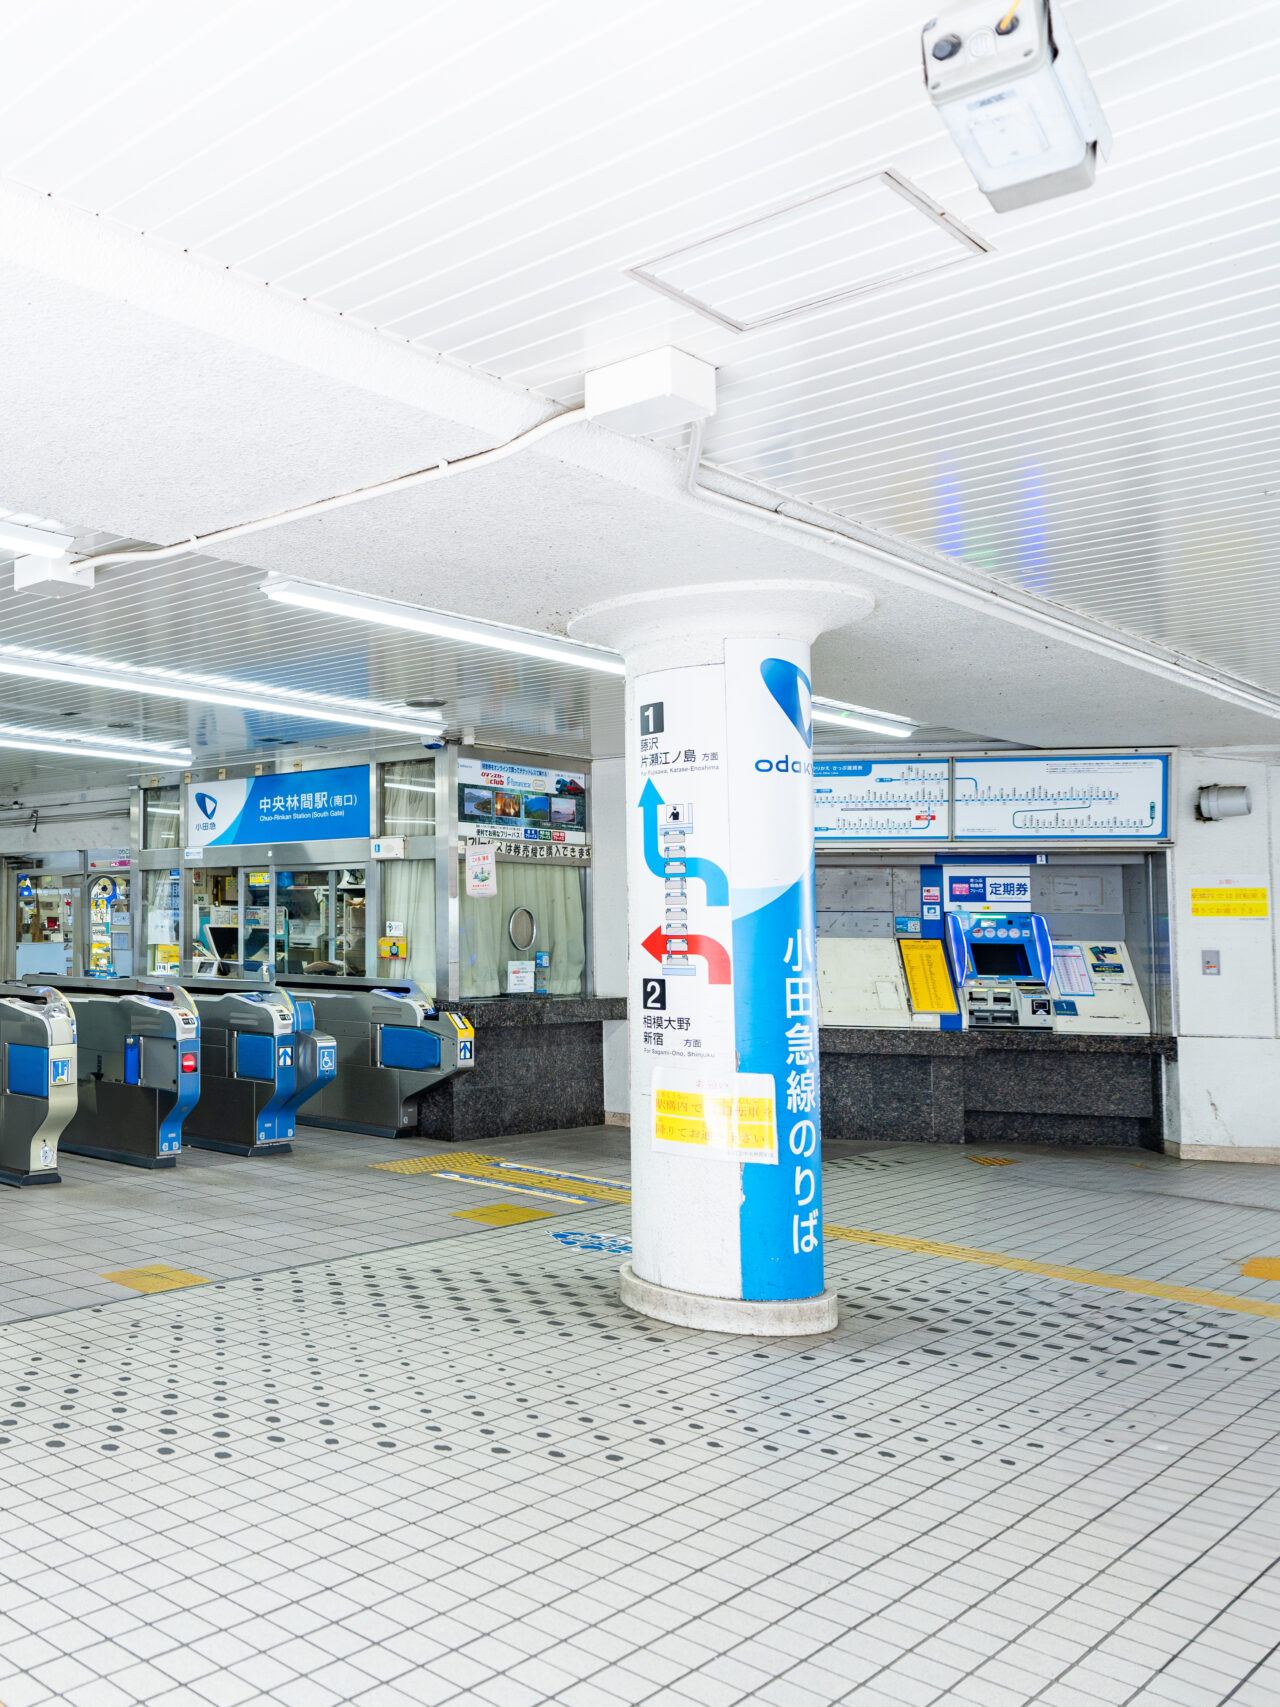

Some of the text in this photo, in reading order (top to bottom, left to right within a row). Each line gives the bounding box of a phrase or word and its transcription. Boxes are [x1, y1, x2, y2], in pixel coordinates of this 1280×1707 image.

[644, 707, 654, 733] 1
[641, 737, 658, 752] 藤沢
[641, 749, 719, 768] 片瀬江ノ島 方面
[259, 791, 358, 813] 中央林間駅(南口)
[260, 809, 345, 822] Chuo-Rinkan Station (South Gate)
[195, 822, 216, 831] 小田急
[989, 883, 1028, 896] 定期券
[647, 981, 661, 1008] 2
[643, 1015, 691, 1031] 相模大野
[643, 1032, 702, 1048] 新宿 方面
[783, 929, 820, 1255] 小田急線のりば
